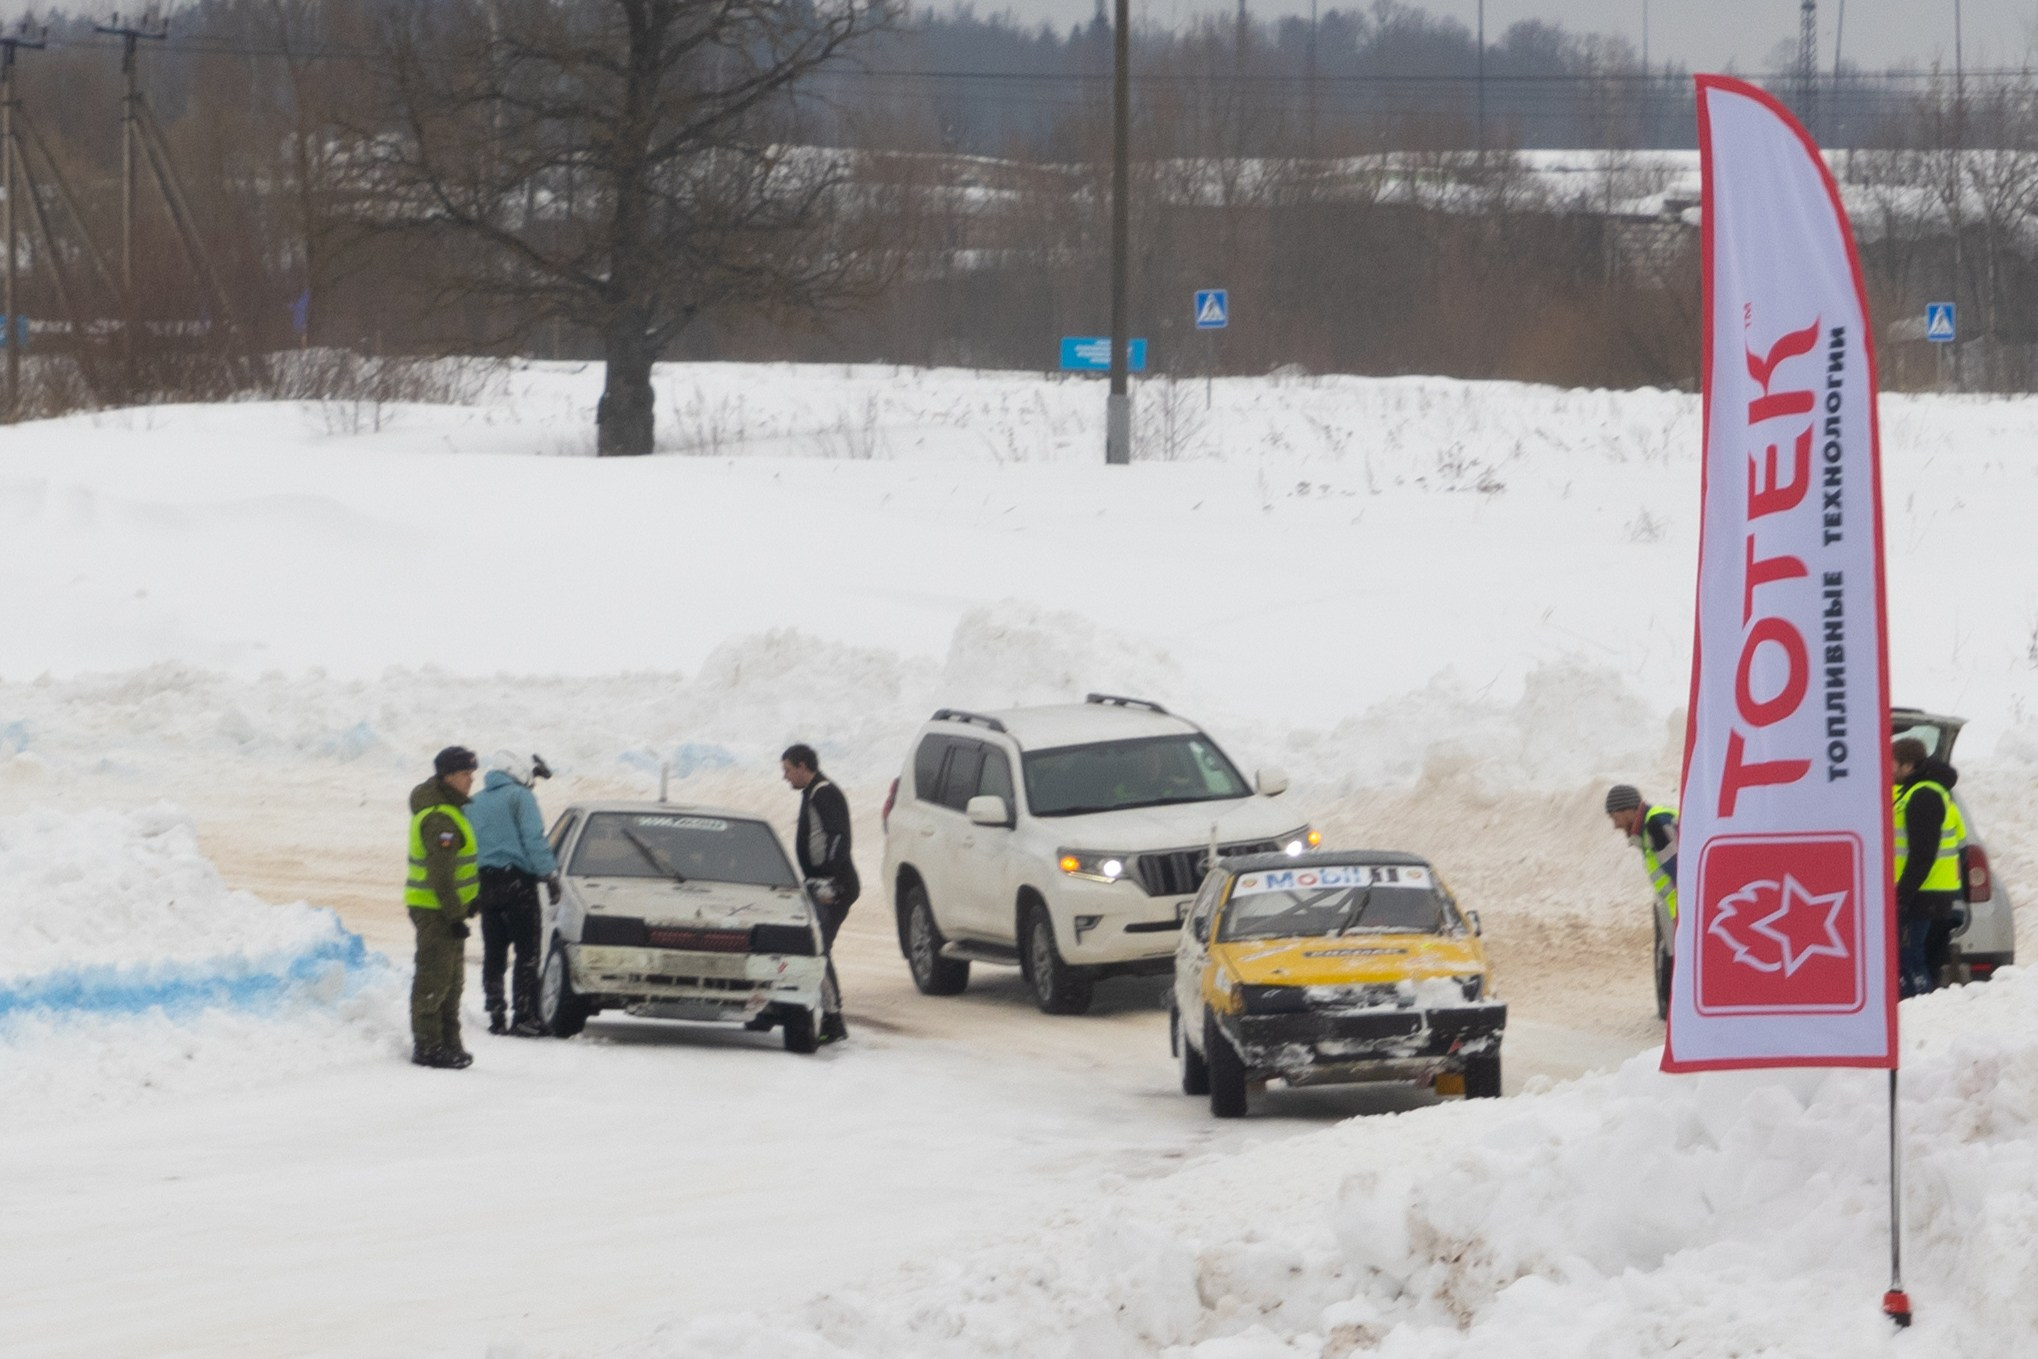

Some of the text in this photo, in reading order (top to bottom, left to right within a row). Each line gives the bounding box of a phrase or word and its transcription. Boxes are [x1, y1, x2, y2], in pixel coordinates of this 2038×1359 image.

[1822, 326, 1848, 783] ТОПЛИВНЫЕ ТЕХНОЛОГИИ
[1265, 866, 1361, 889] Mobil
